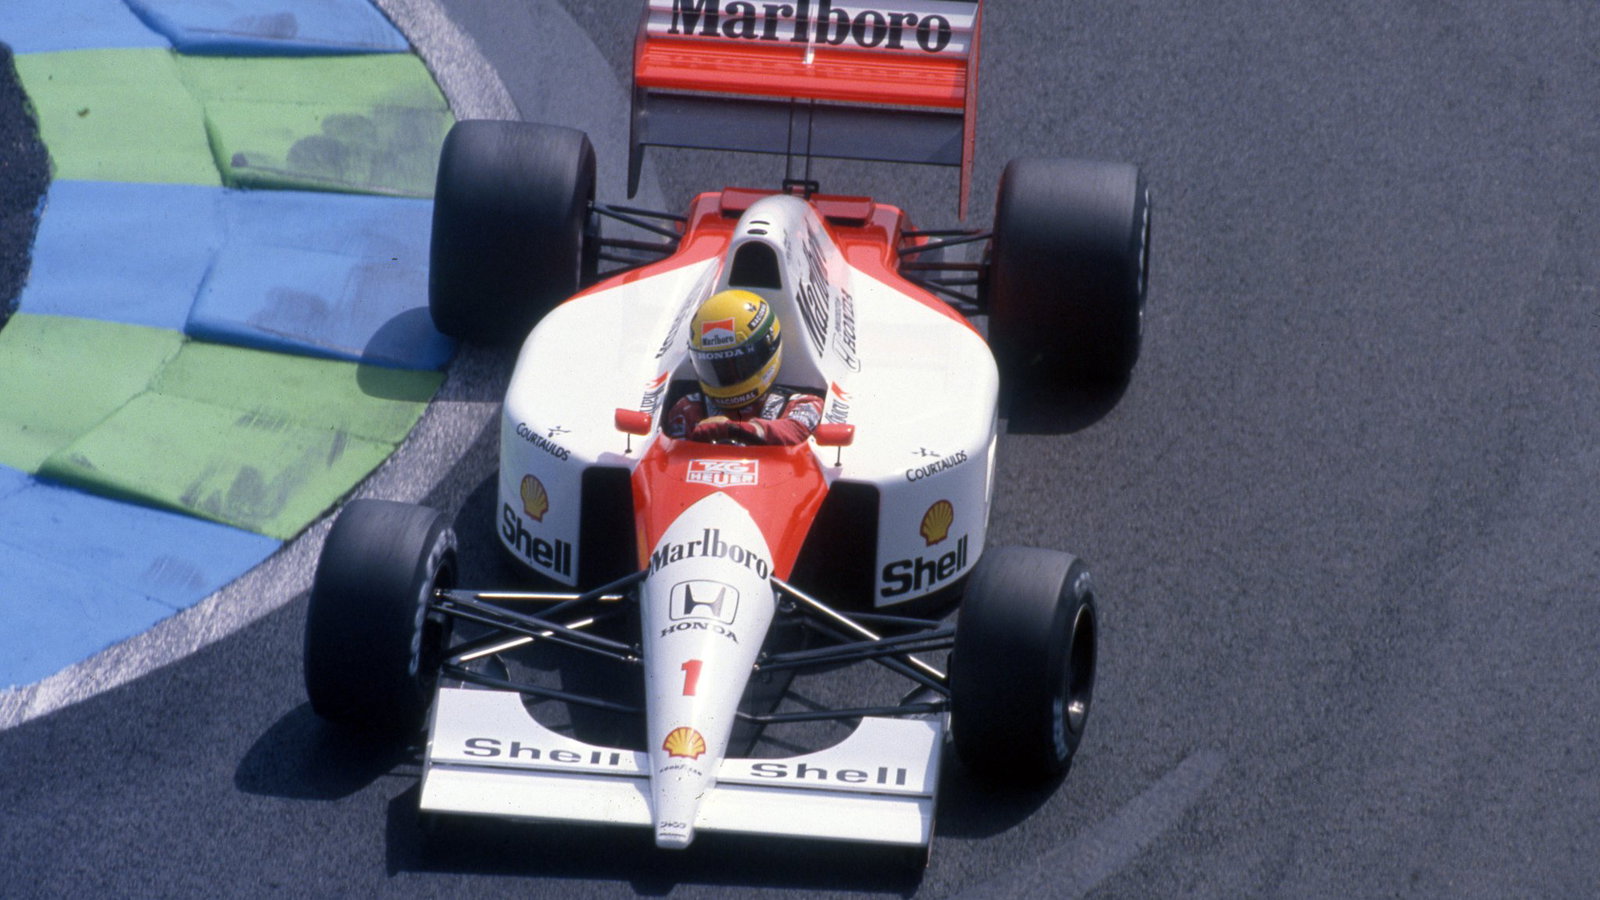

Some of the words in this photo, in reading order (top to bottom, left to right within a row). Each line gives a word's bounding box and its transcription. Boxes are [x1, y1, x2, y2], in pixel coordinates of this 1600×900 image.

[667, 0, 952, 53] Marlboro
[698, 349, 744, 360] HONDA
[702, 334, 735, 346] Marlboro
[516, 422, 571, 462] COURTAULDS
[689, 471, 756, 484] HEUER
[699, 461, 750, 473] TAG
[906, 450, 968, 482] COURTAULDS
[502, 502, 571, 577] Shell
[649, 528, 769, 580] Marlboro
[880, 533, 968, 598] Shell
[660, 622, 739, 645] HONDA
[681, 659, 703, 696] 1
[463, 737, 620, 766] Shell
[750, 763, 907, 786] Shell
